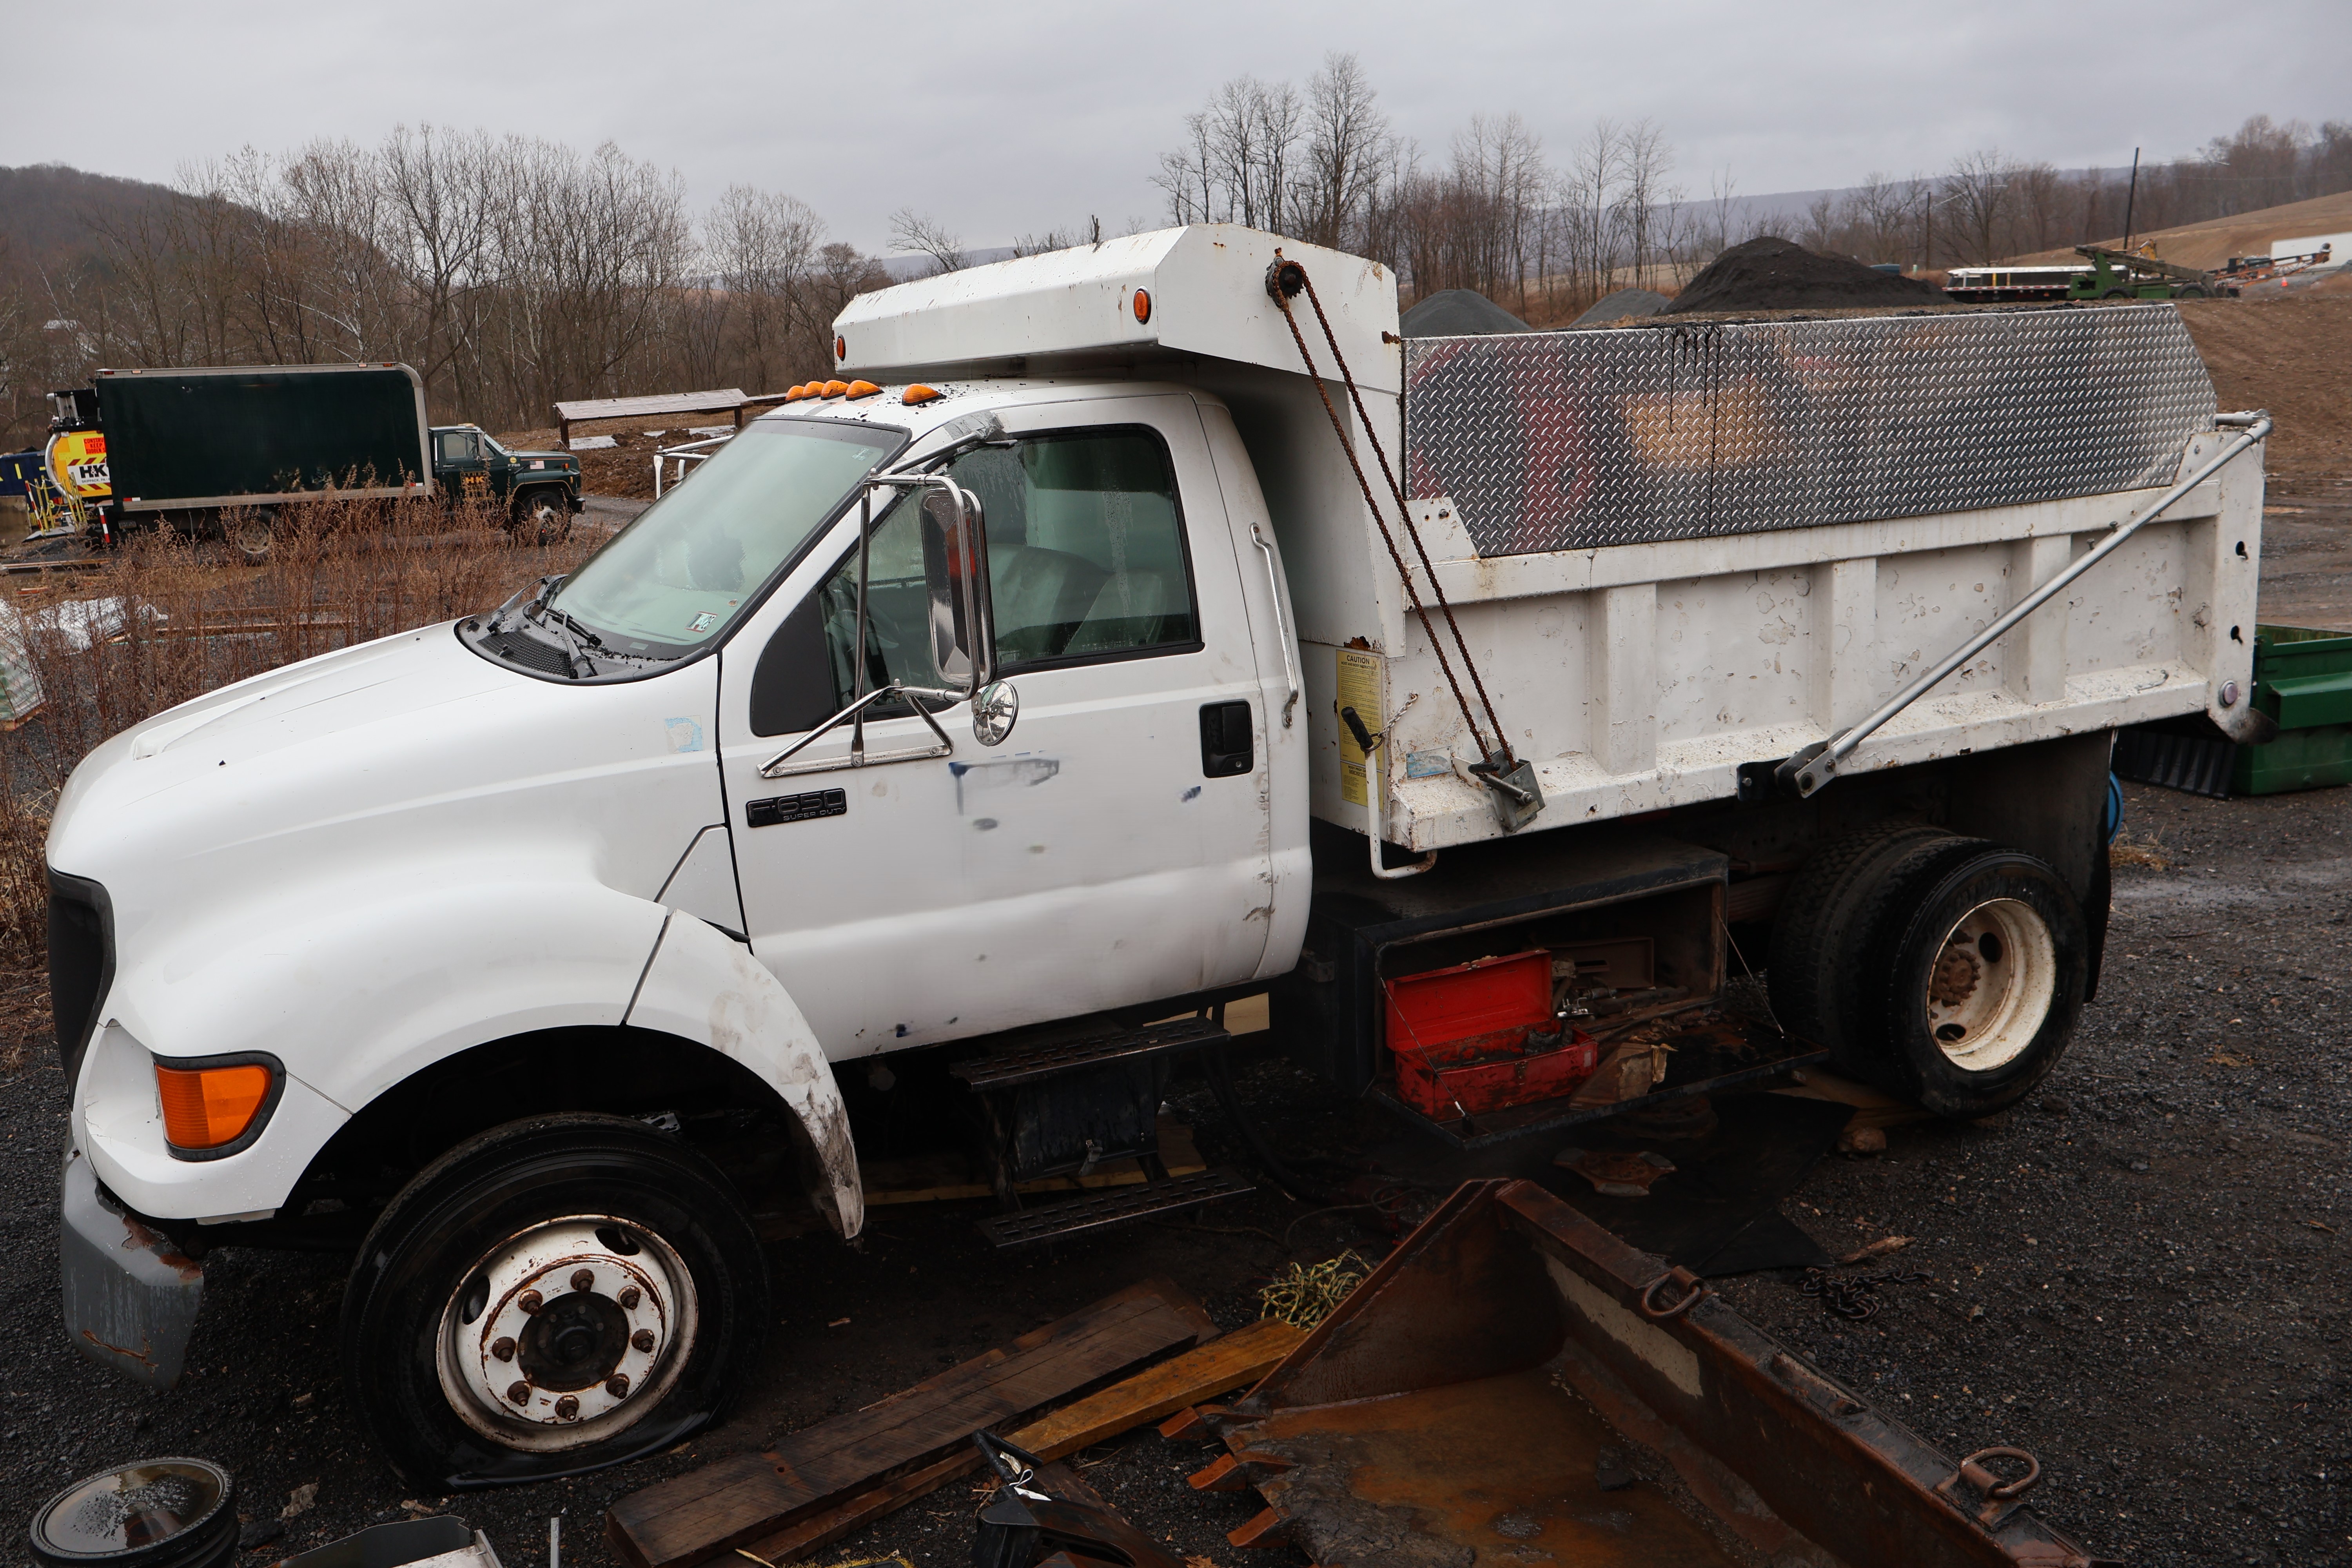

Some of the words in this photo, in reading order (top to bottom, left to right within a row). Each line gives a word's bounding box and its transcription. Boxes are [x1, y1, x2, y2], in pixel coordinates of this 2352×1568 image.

[79, 464, 108, 478] H&K
[1347, 655, 1370, 664] CAUTION
[783, 812, 816, 821] SUPER
[820, 807, 846, 816] DUTY
